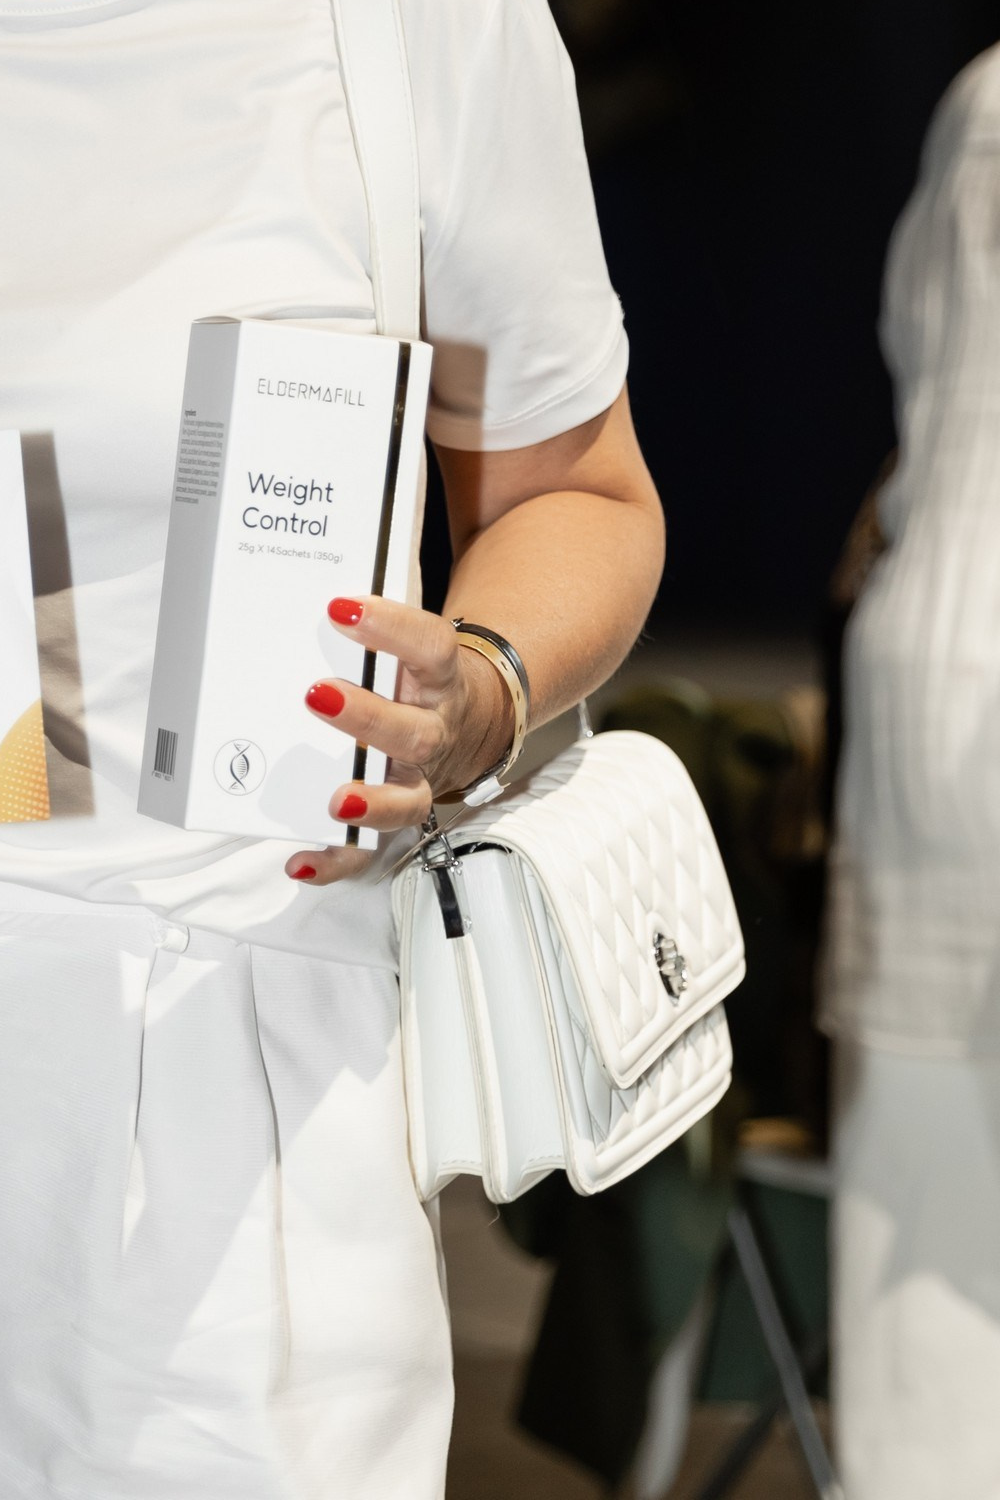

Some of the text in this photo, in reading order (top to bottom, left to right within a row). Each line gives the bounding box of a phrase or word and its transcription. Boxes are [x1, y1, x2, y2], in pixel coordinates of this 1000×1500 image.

[257, 378, 365, 407] ELDERMAFILL
[248, 471, 334, 506] Weight
[242, 507, 328, 537] Control
[238, 542, 255, 554] 25g
[267, 545, 311, 559] 14Sachets
[314, 551, 343, 565] (350g)
